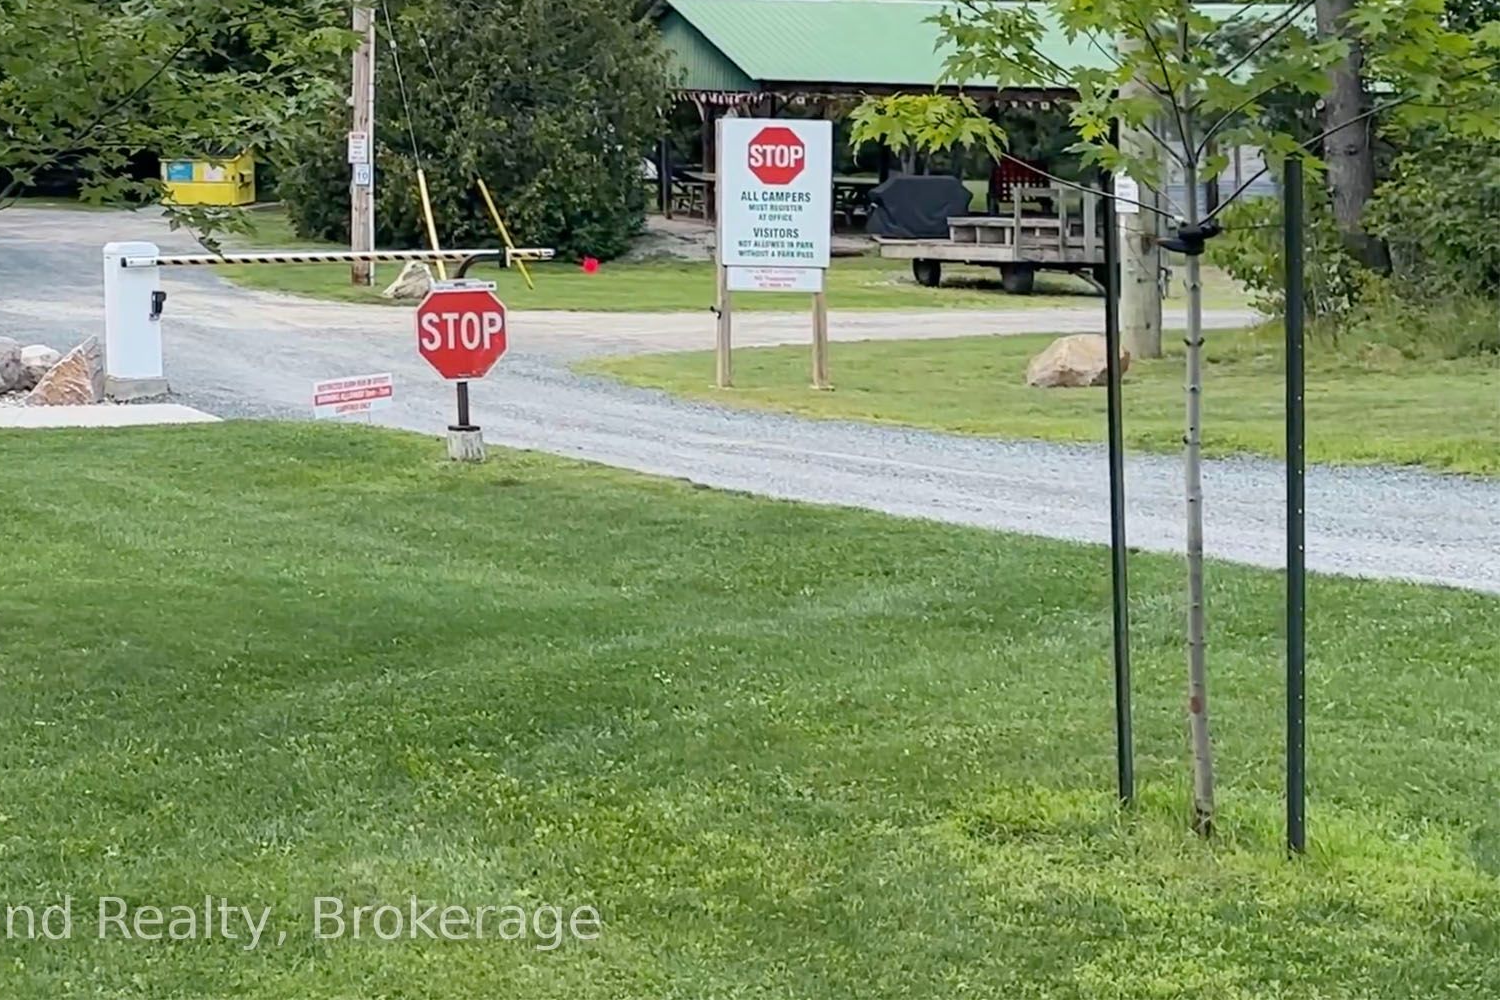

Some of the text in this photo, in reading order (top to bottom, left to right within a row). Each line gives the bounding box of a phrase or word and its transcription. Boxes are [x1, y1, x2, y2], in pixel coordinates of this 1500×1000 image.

[750, 144, 804, 168] STOP
[741, 191, 812, 203] ALL CAMPERS
[748, 204, 803, 212] MUST REGISTER
[758, 213, 793, 222] AT OFFICE
[753, 227, 800, 239] VISITORS
[421, 311, 502, 351] STOP
